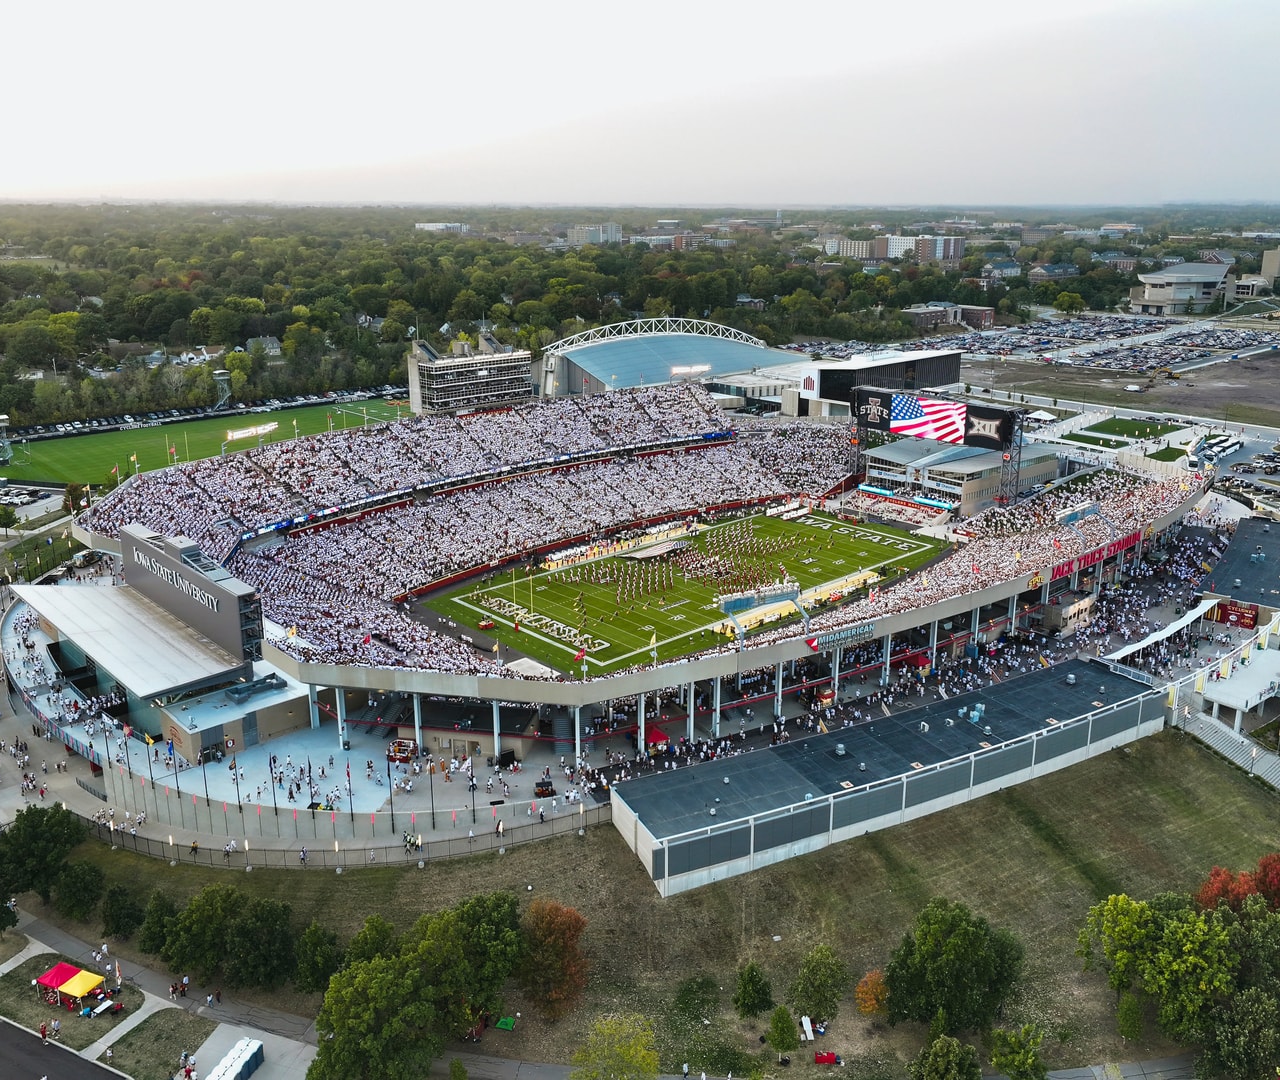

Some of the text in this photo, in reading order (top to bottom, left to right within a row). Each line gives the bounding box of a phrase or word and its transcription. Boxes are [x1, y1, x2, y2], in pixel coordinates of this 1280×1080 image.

[860, 406, 889, 419] STATE
[833, 527, 917, 551] STATE
[1050, 559, 1075, 581] JACK
[1077, 548, 1105, 570] TRICE
[1107, 531, 1142, 557] STADIUM
[133, 546, 219, 612] IOWA STATE UNIVERSITY
[818, 623, 875, 644] MIDAMERICAN
